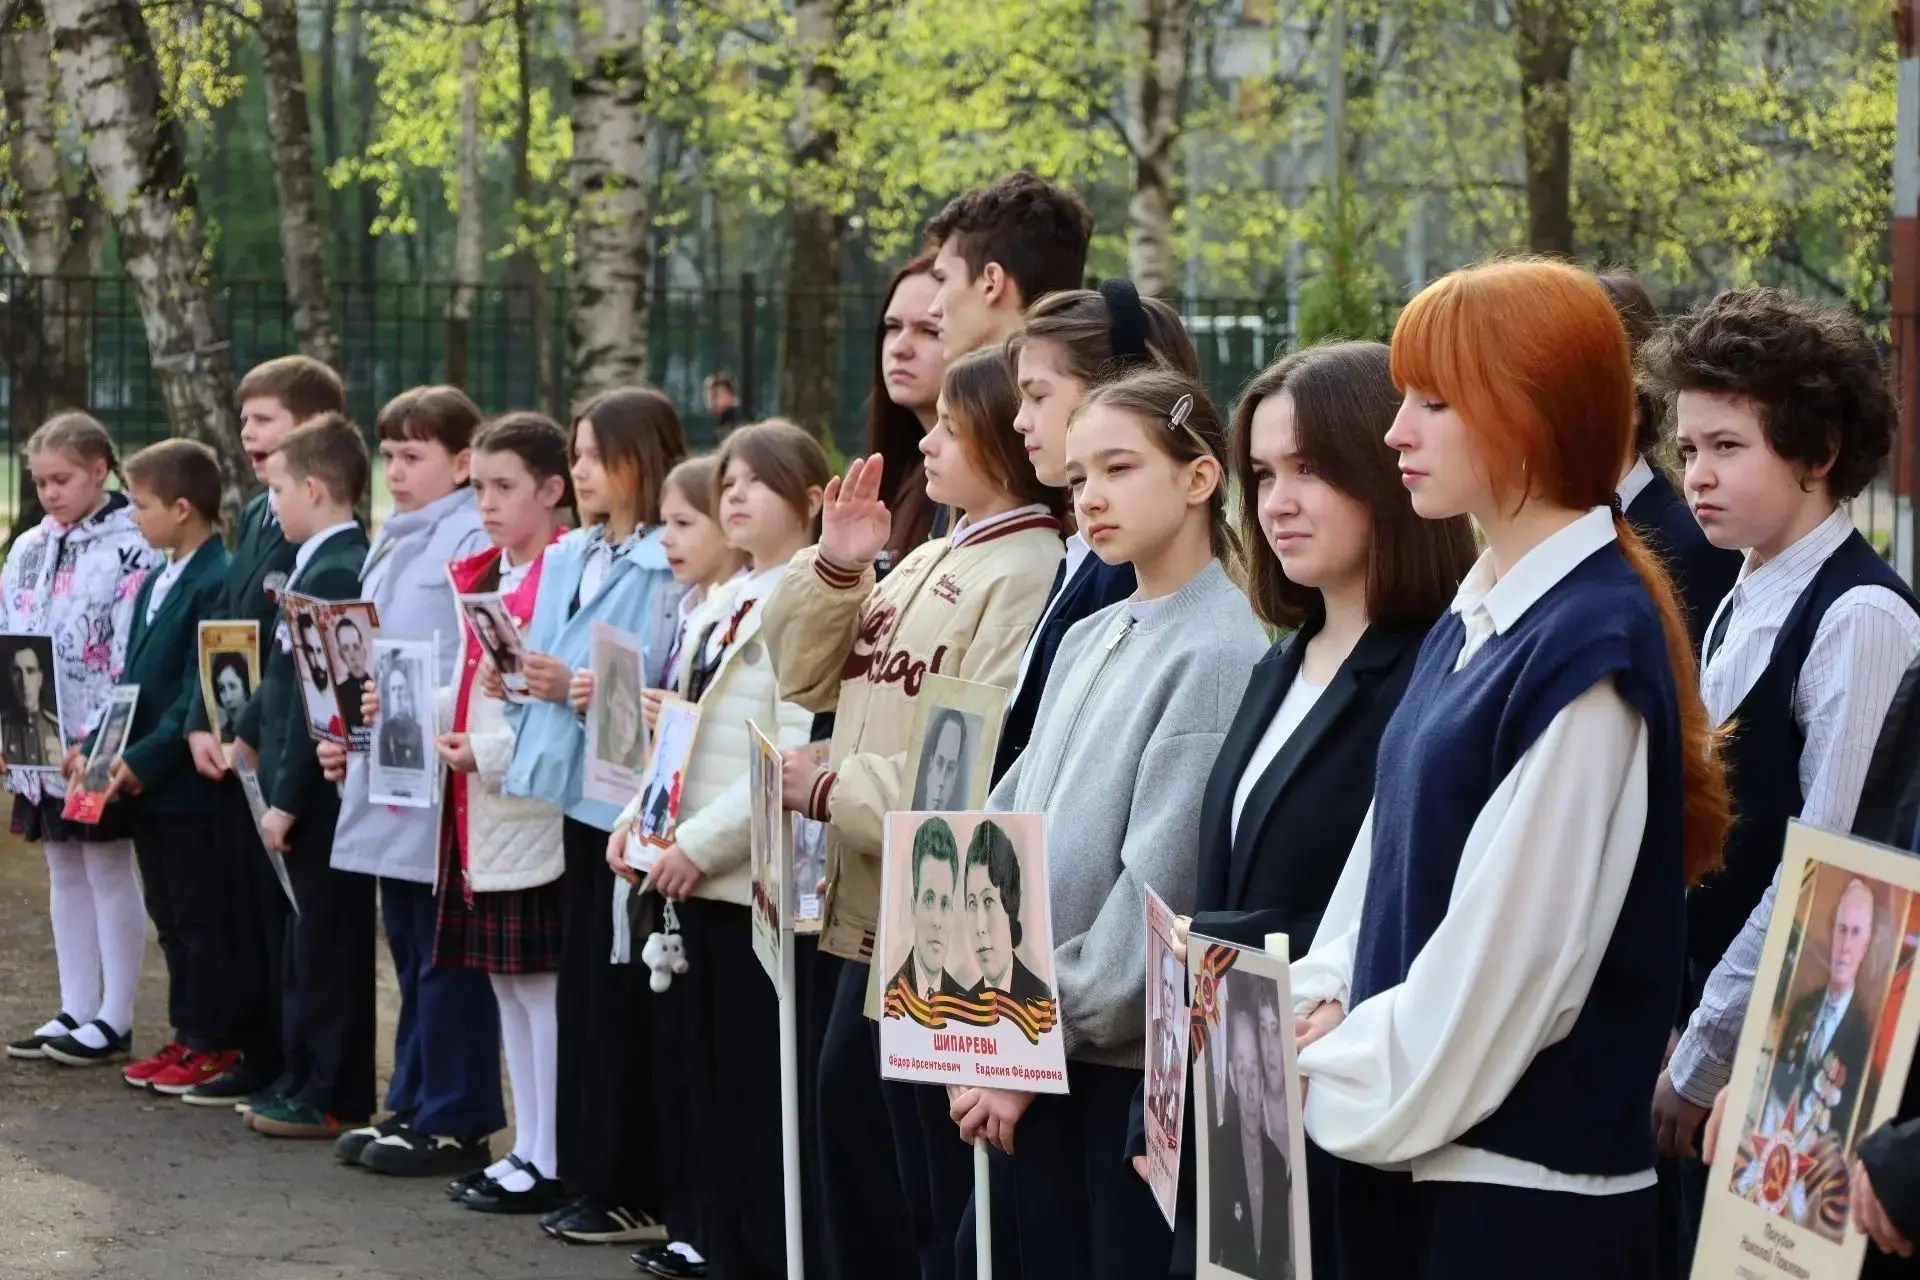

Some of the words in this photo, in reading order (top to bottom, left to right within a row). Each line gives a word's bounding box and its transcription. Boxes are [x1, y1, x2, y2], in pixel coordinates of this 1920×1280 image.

[933, 1033, 998, 1055] ШИПАРЕВЫ
[888, 1053, 911, 1069] Фёдор
[911, 1056, 961, 1073] Арсентьевич
[975, 1062, 1010, 1077] Евдокия
[1011, 1065, 1063, 1081] Фёдоровна
